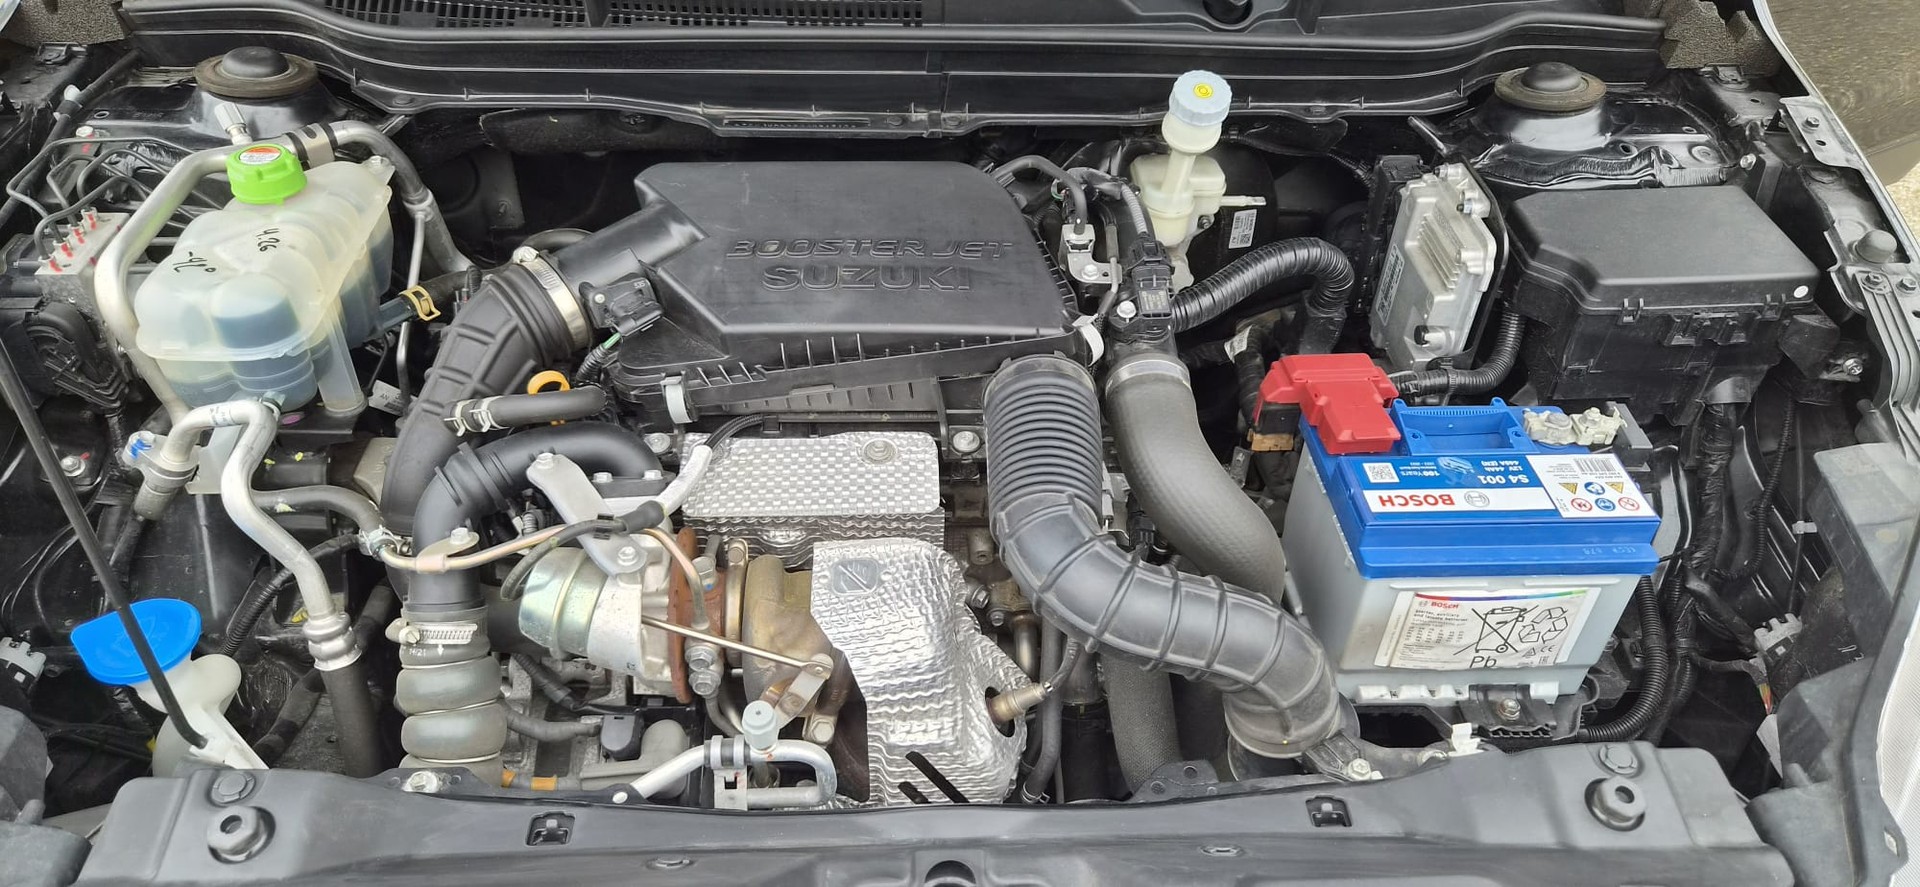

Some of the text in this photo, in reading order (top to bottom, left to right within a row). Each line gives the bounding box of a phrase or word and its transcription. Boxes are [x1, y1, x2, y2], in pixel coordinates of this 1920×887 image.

[762, 265, 971, 292] SUZUKI
[1477, 474, 1506, 484] 001
[1378, 493, 1455, 507] BOSCH
[1431, 601, 1459, 609] BOSCH
[1469, 655, 1497, 668] Pb
